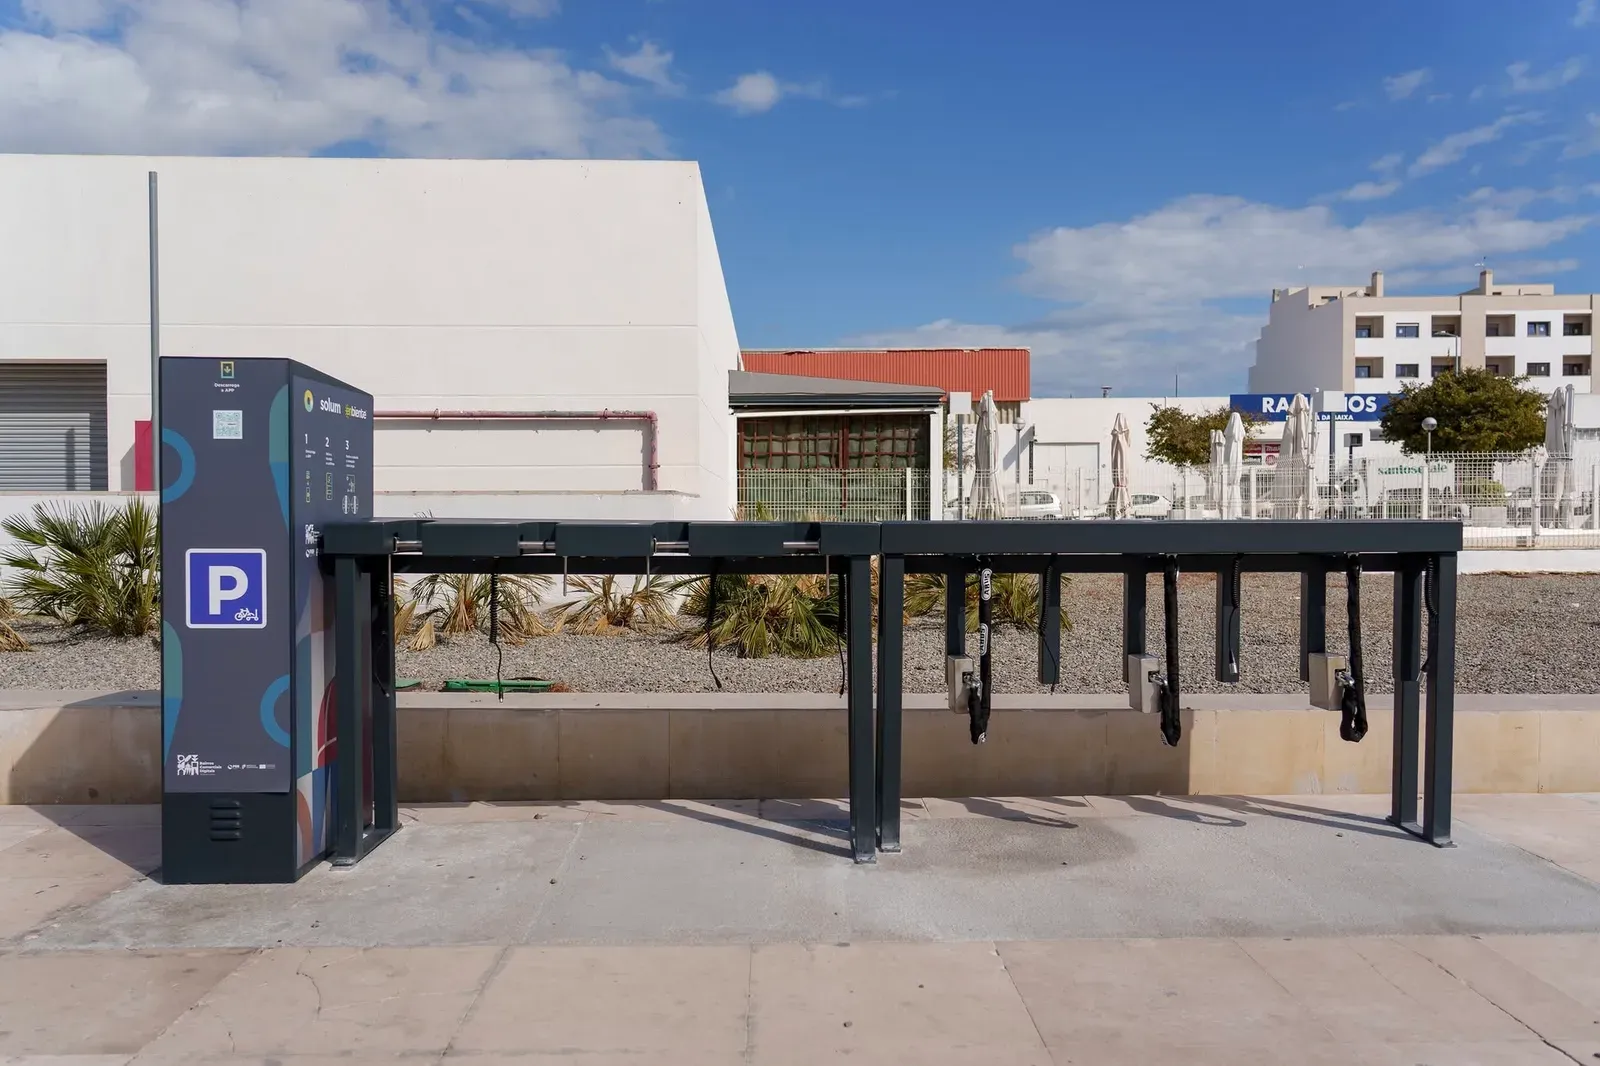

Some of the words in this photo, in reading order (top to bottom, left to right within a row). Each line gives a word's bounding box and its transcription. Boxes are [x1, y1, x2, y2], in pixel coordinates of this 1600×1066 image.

[320, 397, 342, 414] solum
[304, 434, 308, 444] 1
[325, 437, 330, 448] 2
[345, 440, 350, 450] 3
[208, 566, 249, 616] P
